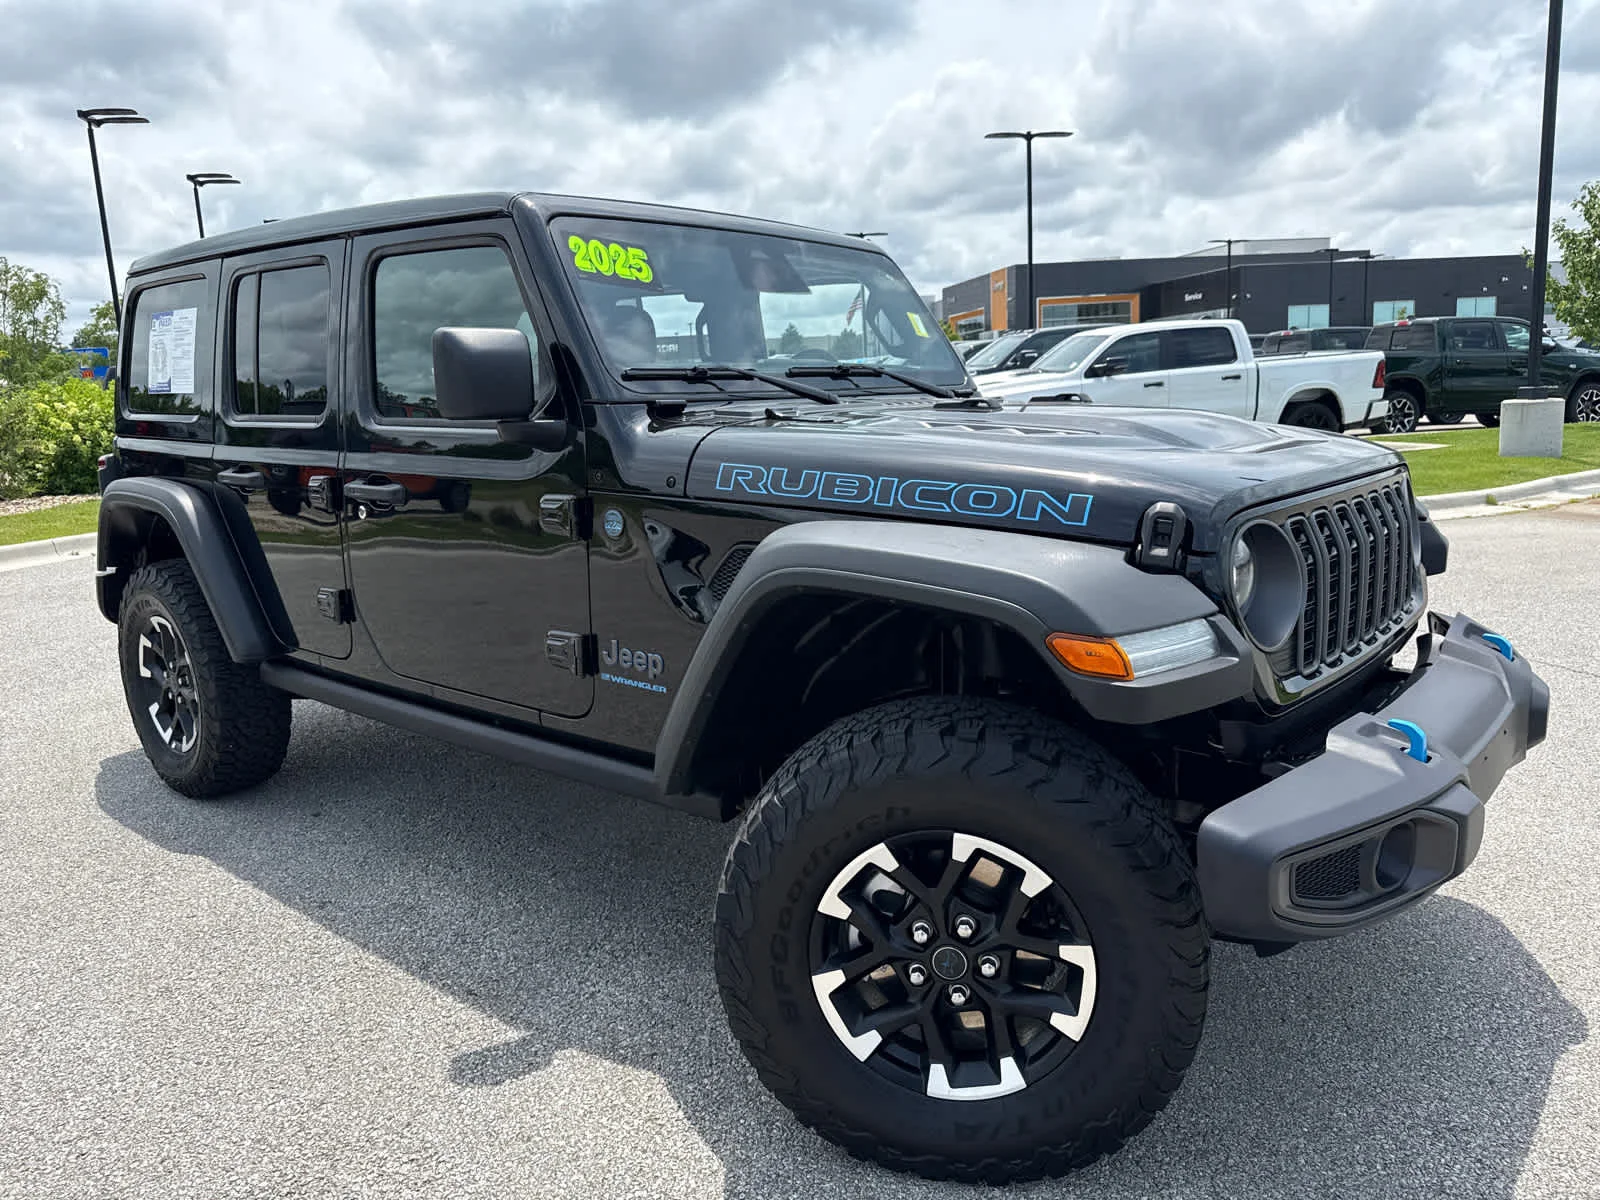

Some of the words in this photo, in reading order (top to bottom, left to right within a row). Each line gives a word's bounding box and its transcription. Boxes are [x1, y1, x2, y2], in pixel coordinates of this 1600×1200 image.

[568, 235, 653, 283] 2025
[715, 463, 1093, 526] RUBICON
[602, 640, 664, 679] Jeep
